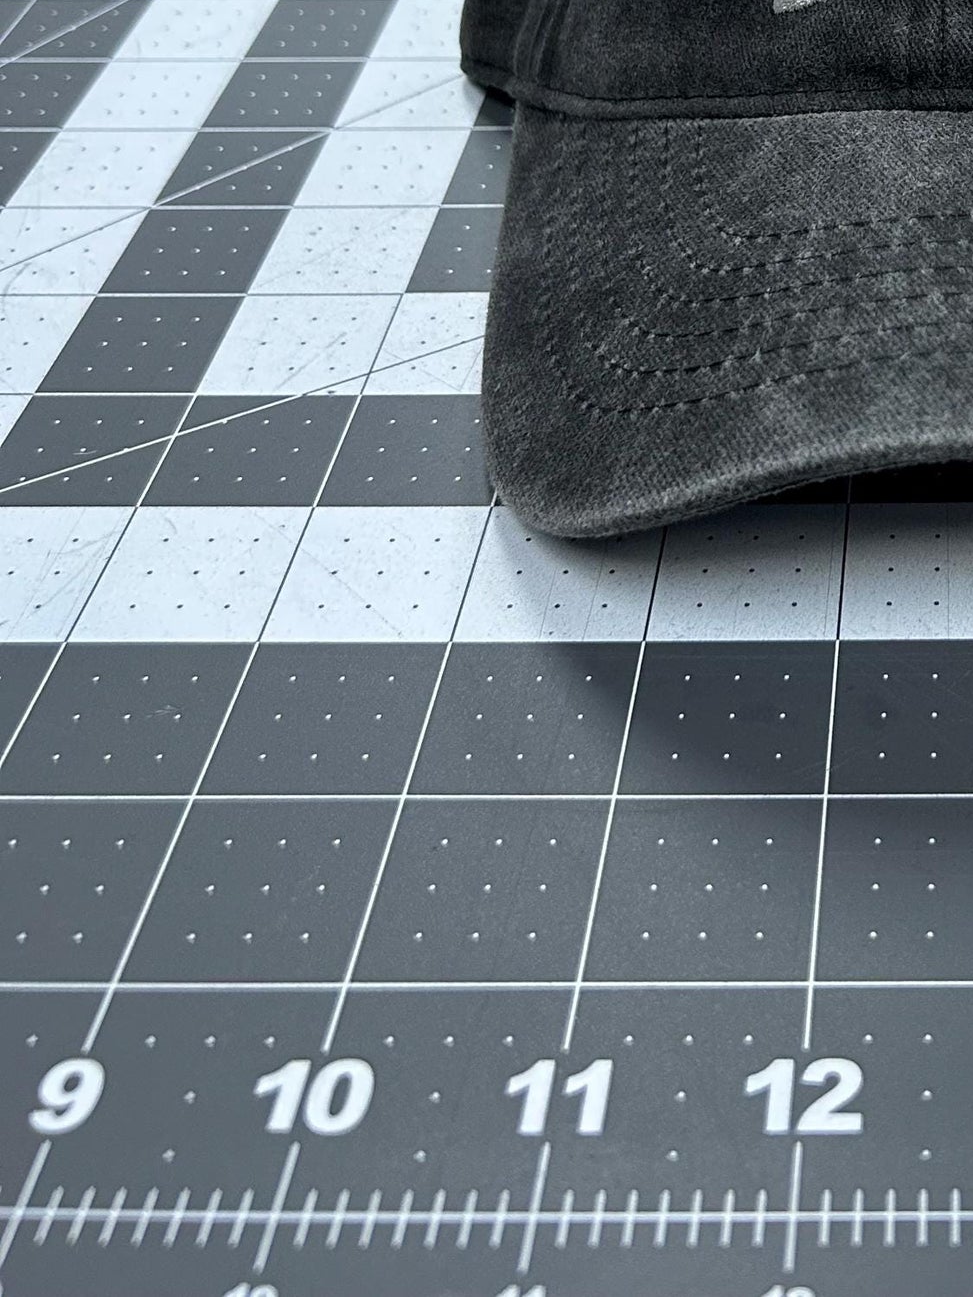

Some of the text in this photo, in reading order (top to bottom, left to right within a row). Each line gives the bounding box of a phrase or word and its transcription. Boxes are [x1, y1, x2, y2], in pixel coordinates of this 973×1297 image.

[30, 1058, 104, 1133] 9
[254, 1058, 374, 1134] 10
[506, 1059, 613, 1135] 11
[745, 1058, 863, 1134] 12
